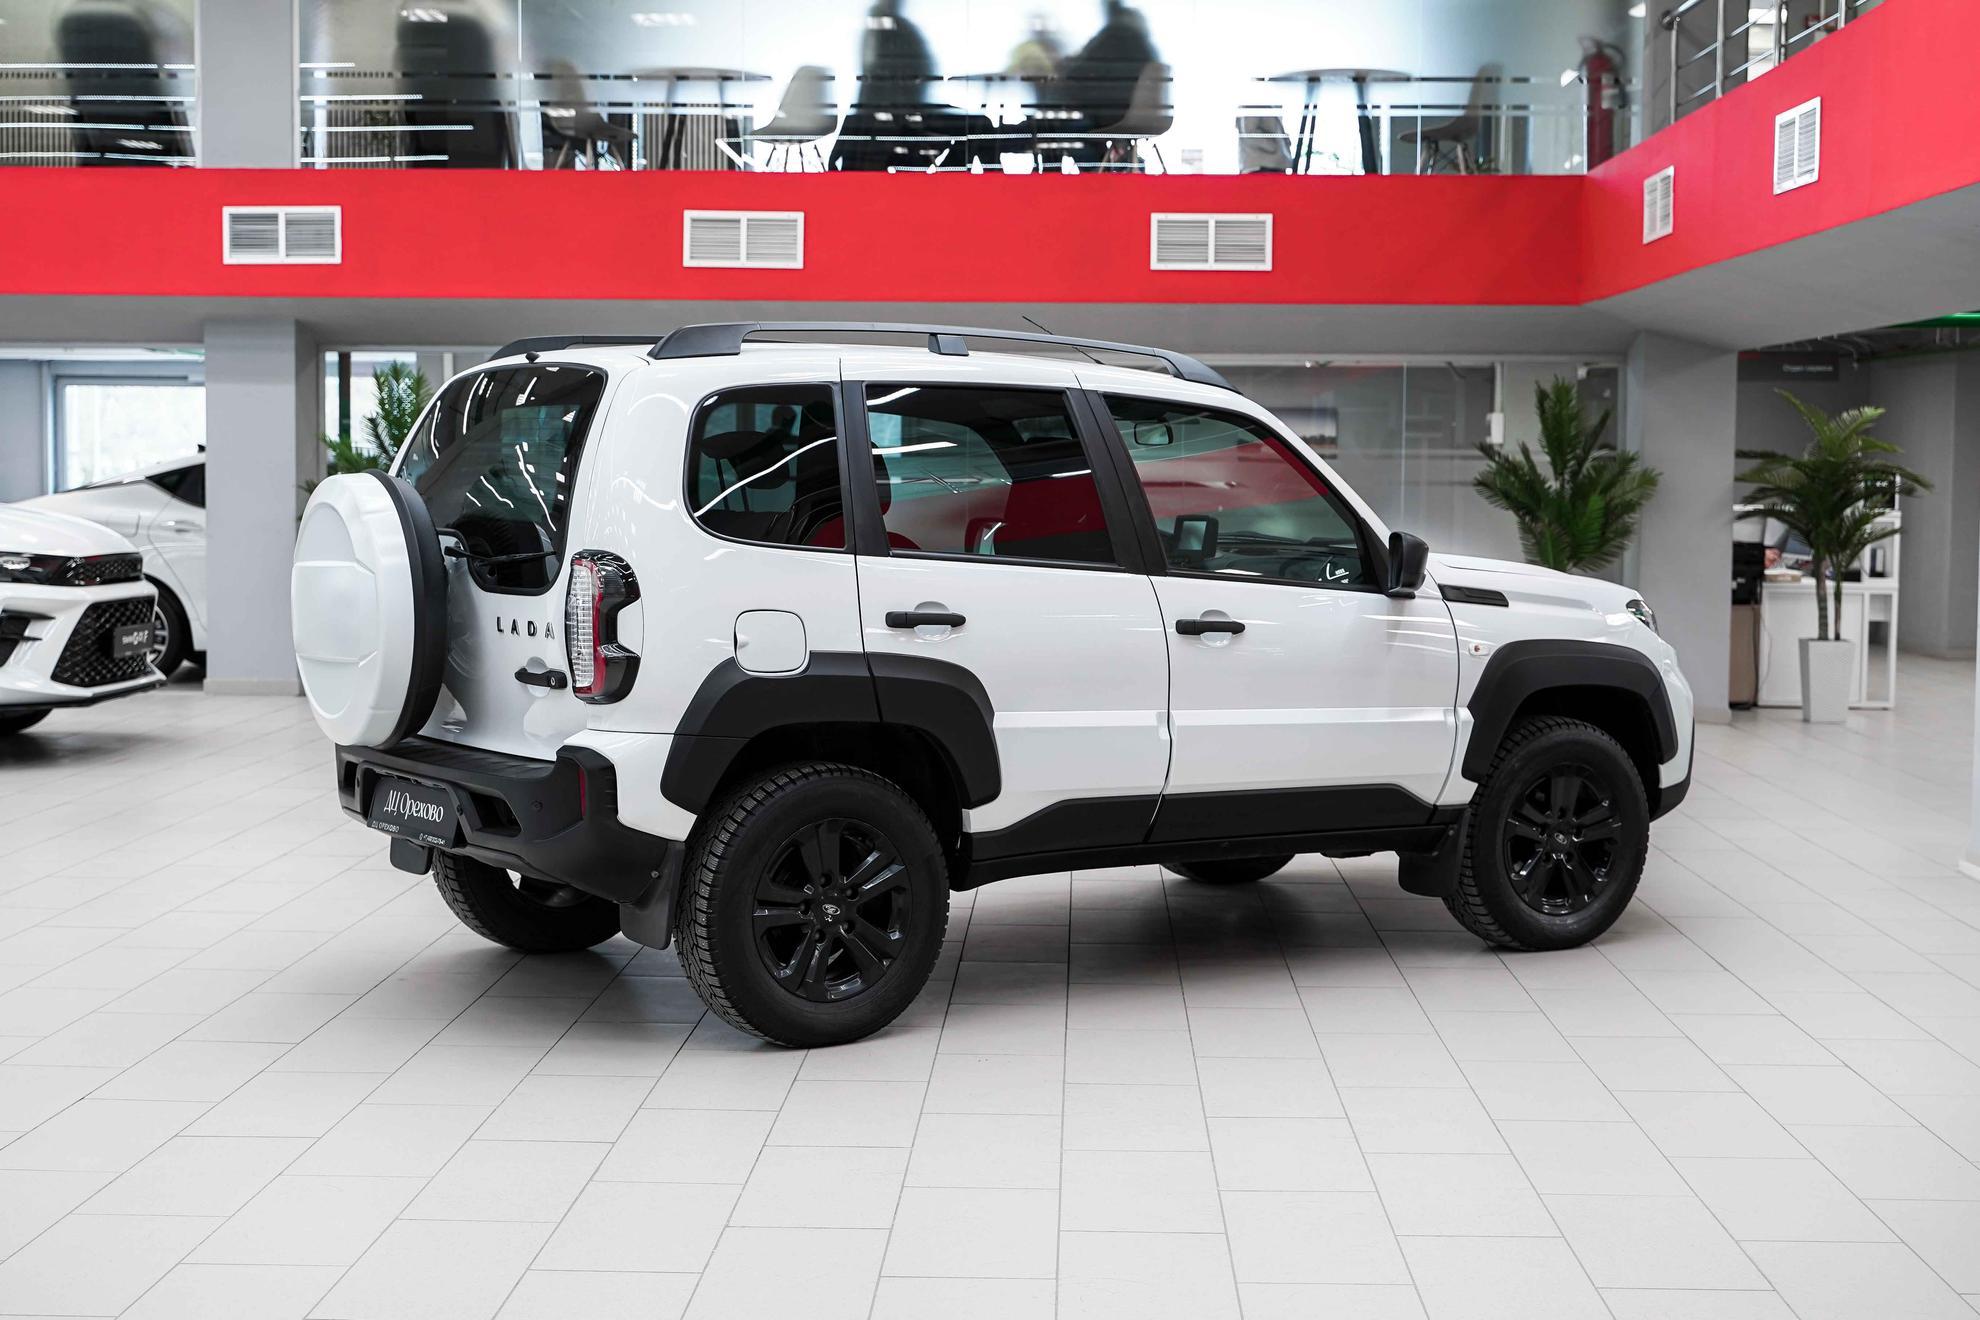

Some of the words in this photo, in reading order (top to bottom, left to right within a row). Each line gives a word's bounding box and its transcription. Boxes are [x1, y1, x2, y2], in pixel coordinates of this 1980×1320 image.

[496, 616, 555, 639] LADA
[384, 790, 401, 815] ДЦ
[401, 793, 443, 822] Орехово
[379, 822, 400, 833] ОРЕХОВО
